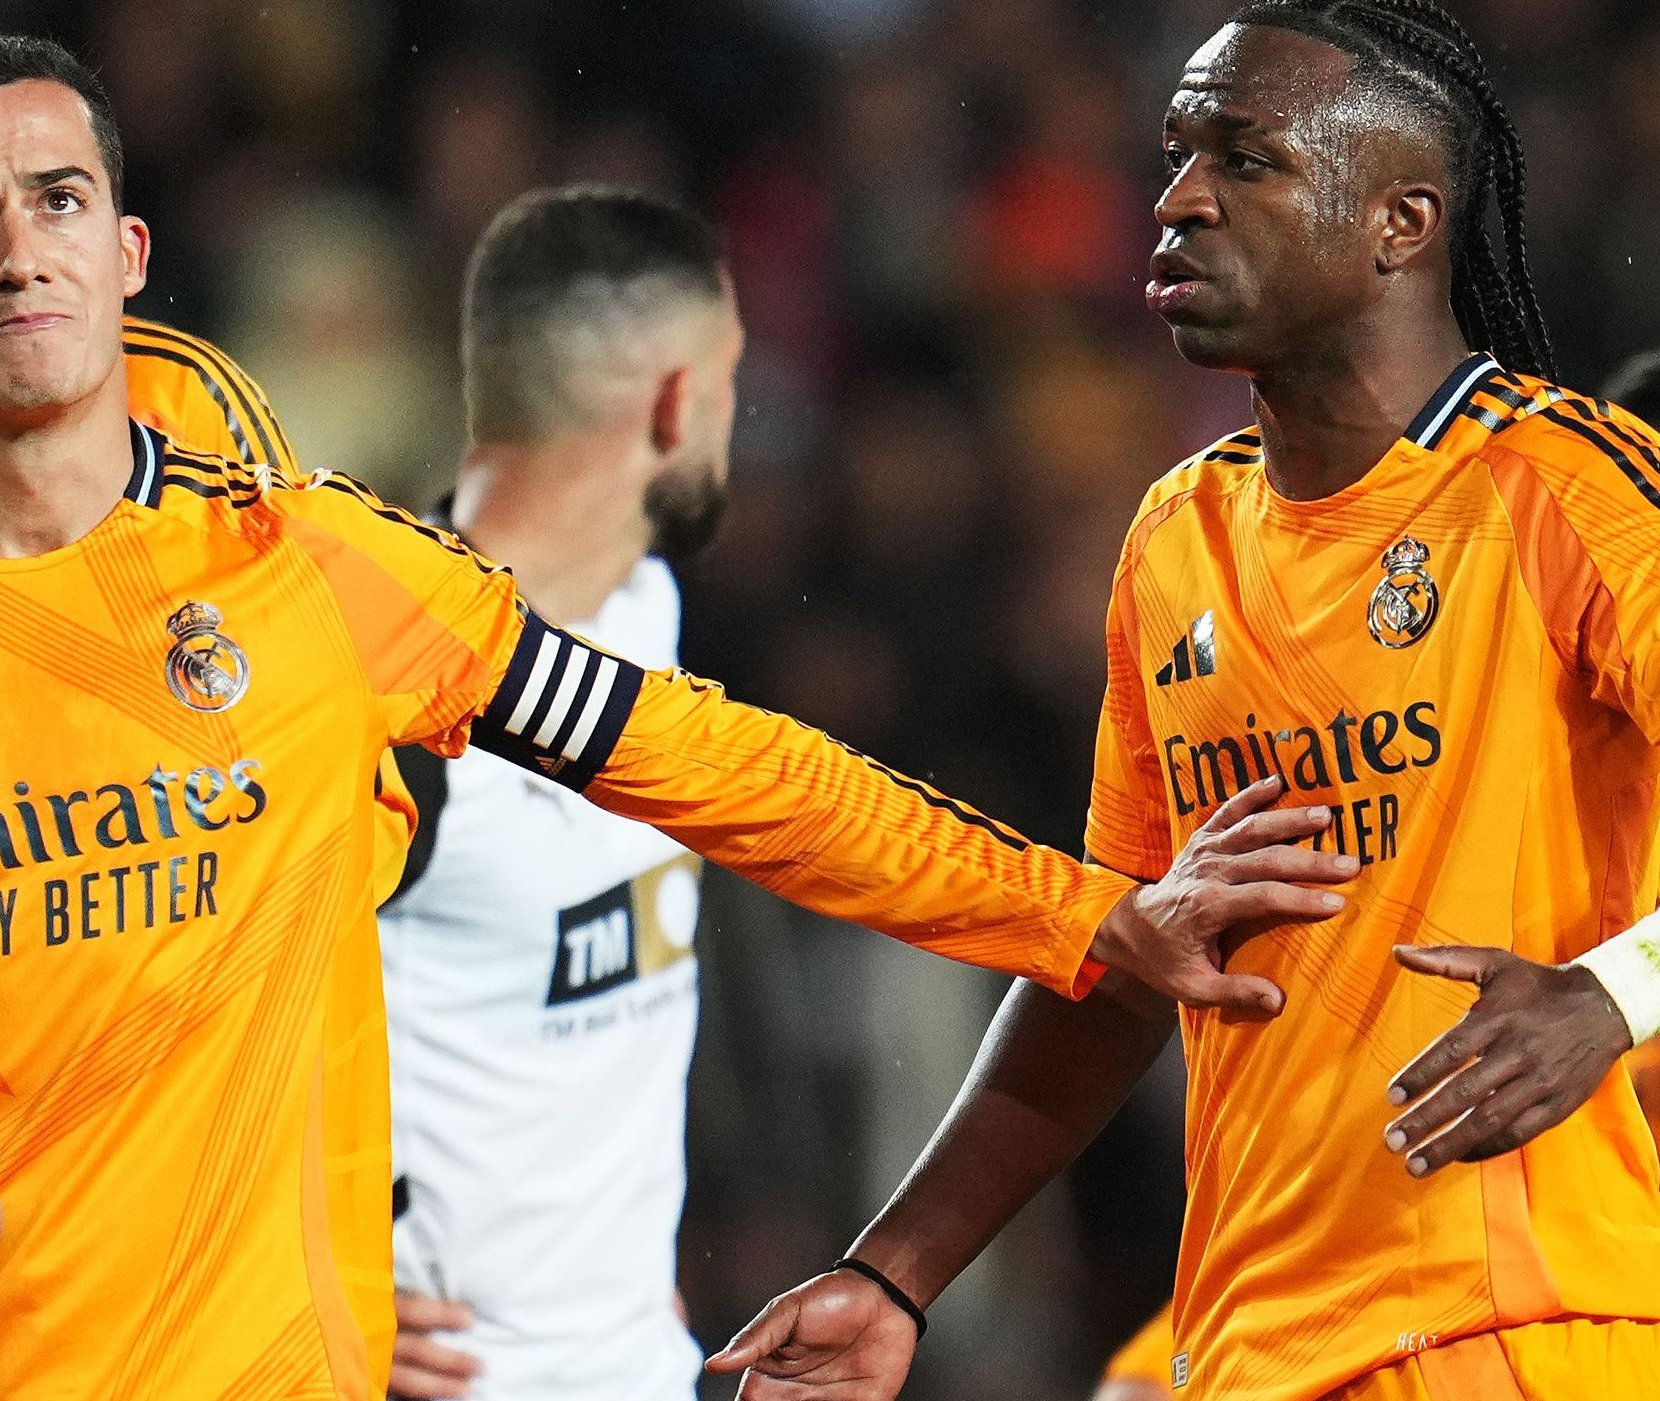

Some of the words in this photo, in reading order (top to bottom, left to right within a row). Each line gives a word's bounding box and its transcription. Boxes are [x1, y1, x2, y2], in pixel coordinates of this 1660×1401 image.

[1164, 701, 1442, 817] Emirates
[44, 851, 218, 948] BETTER
[564, 907, 630, 989] TM
